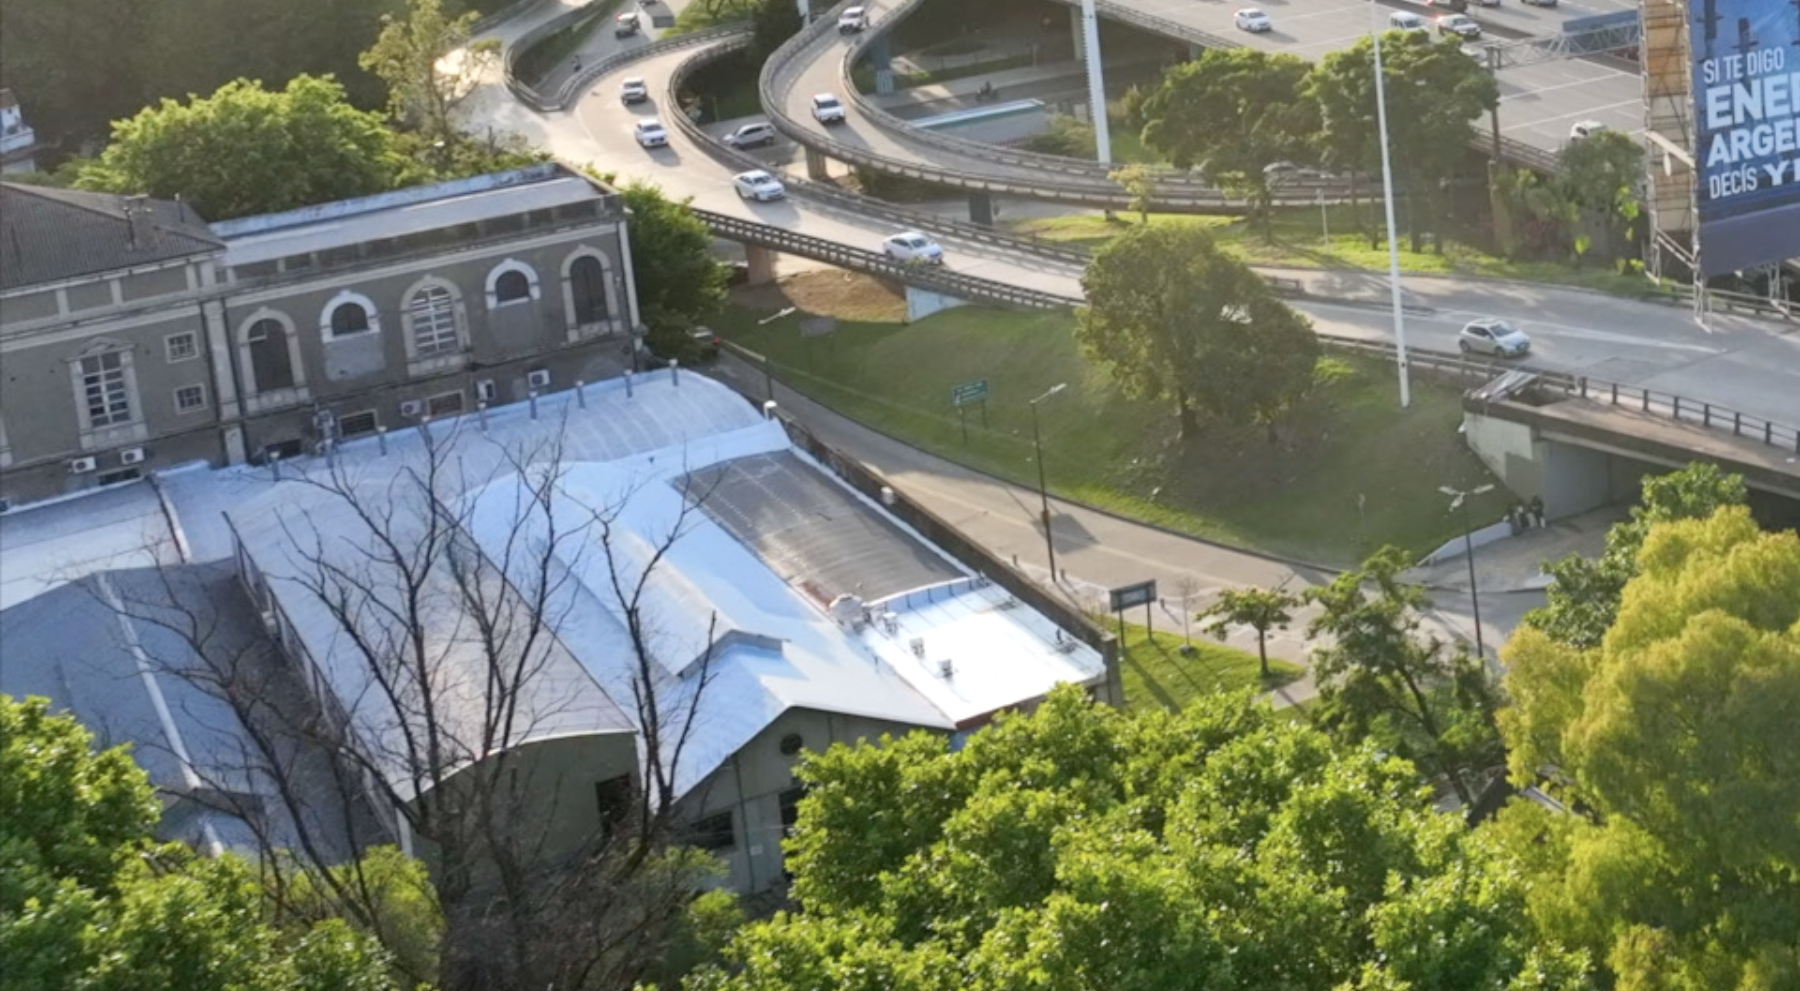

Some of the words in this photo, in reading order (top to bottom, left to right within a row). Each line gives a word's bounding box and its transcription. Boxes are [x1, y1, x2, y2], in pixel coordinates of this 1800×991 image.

[1703, 59, 1720, 85] SI
[1723, 54, 1743, 81] TE
[1747, 46, 1785, 76] DIGO
[1709, 163, 1758, 200] DECÍS
